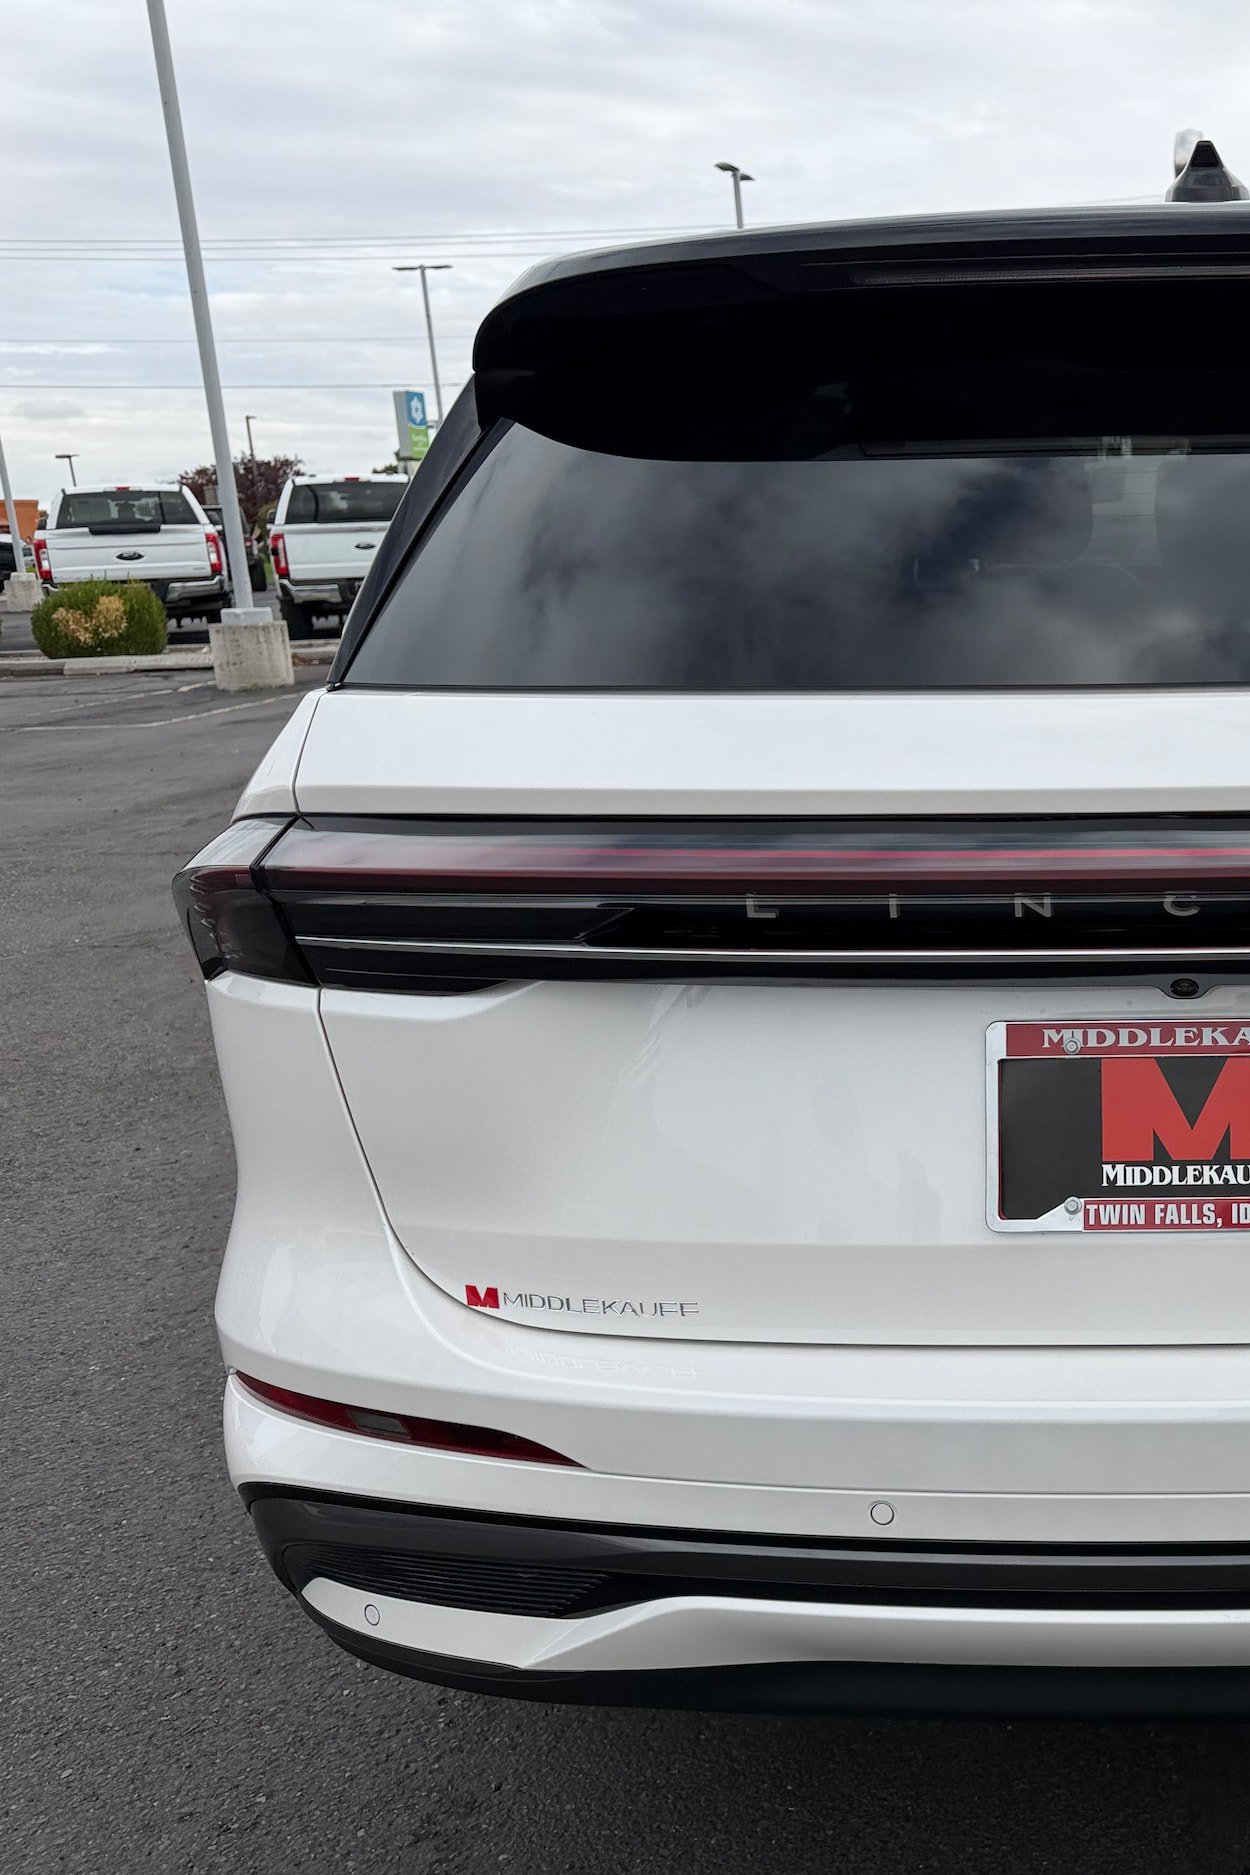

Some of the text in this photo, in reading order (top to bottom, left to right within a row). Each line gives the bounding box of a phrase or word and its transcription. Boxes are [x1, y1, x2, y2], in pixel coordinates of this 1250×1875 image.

[1086, 1204, 1145, 1225] TWIN
[1154, 1203, 1223, 1228] FALLS,
[465, 1285, 699, 1317] M MIDDLEKAUFF
